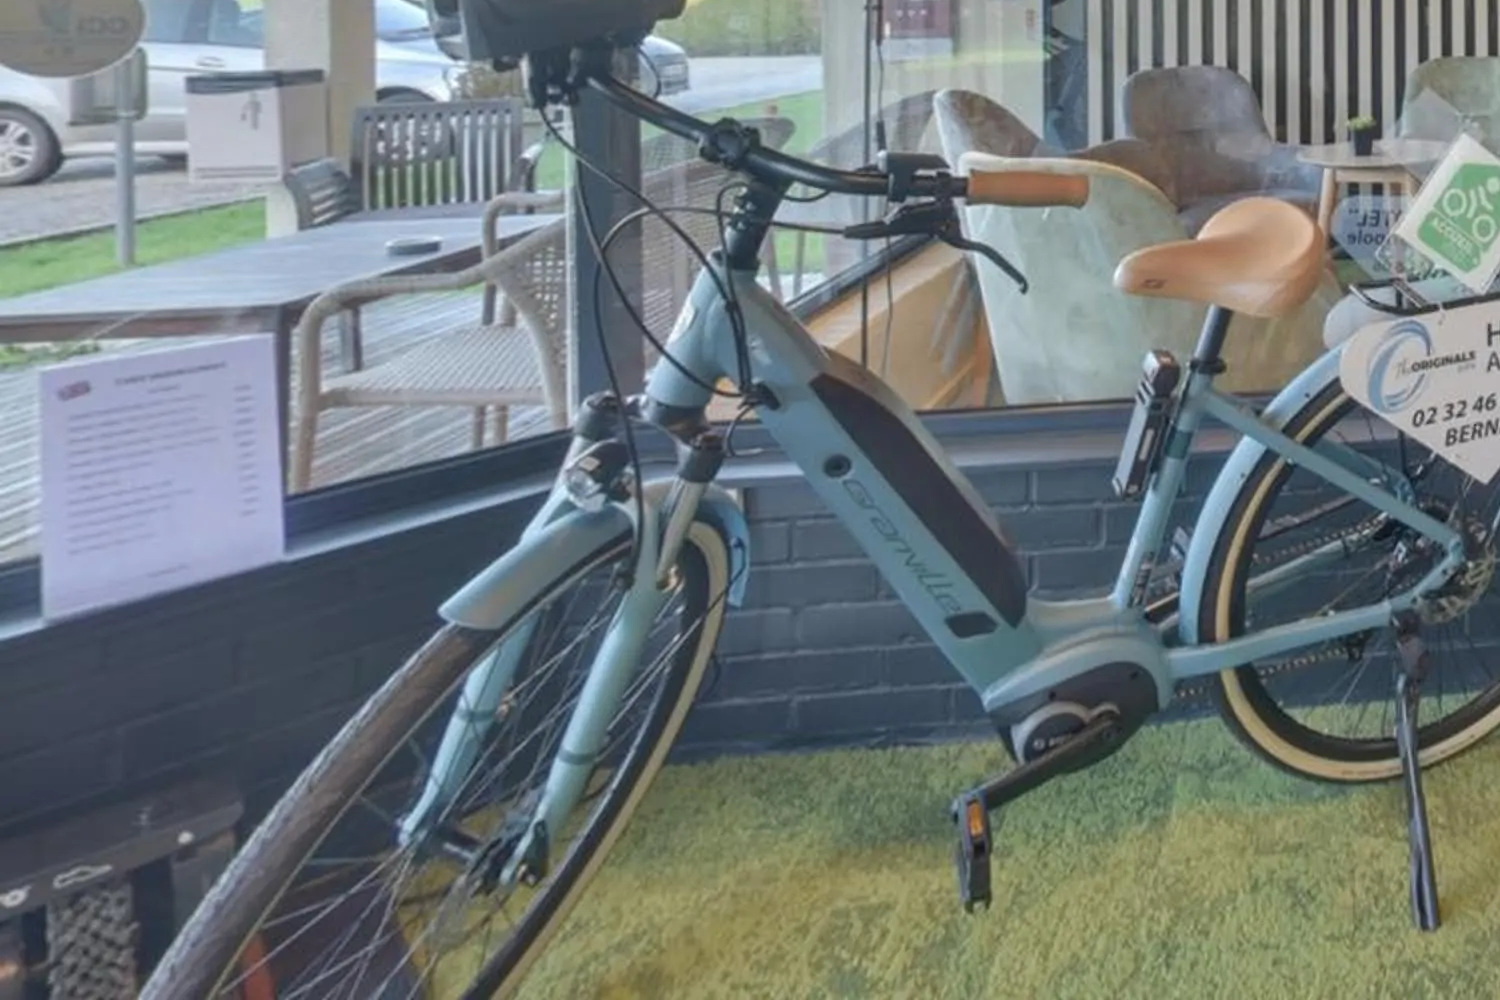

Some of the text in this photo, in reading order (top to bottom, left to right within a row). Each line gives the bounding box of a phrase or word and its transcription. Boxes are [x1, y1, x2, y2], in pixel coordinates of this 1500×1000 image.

[1412, 406, 1438, 428] 02
[1443, 400, 1467, 422] 32
[1472, 393, 1497, 413] 46
